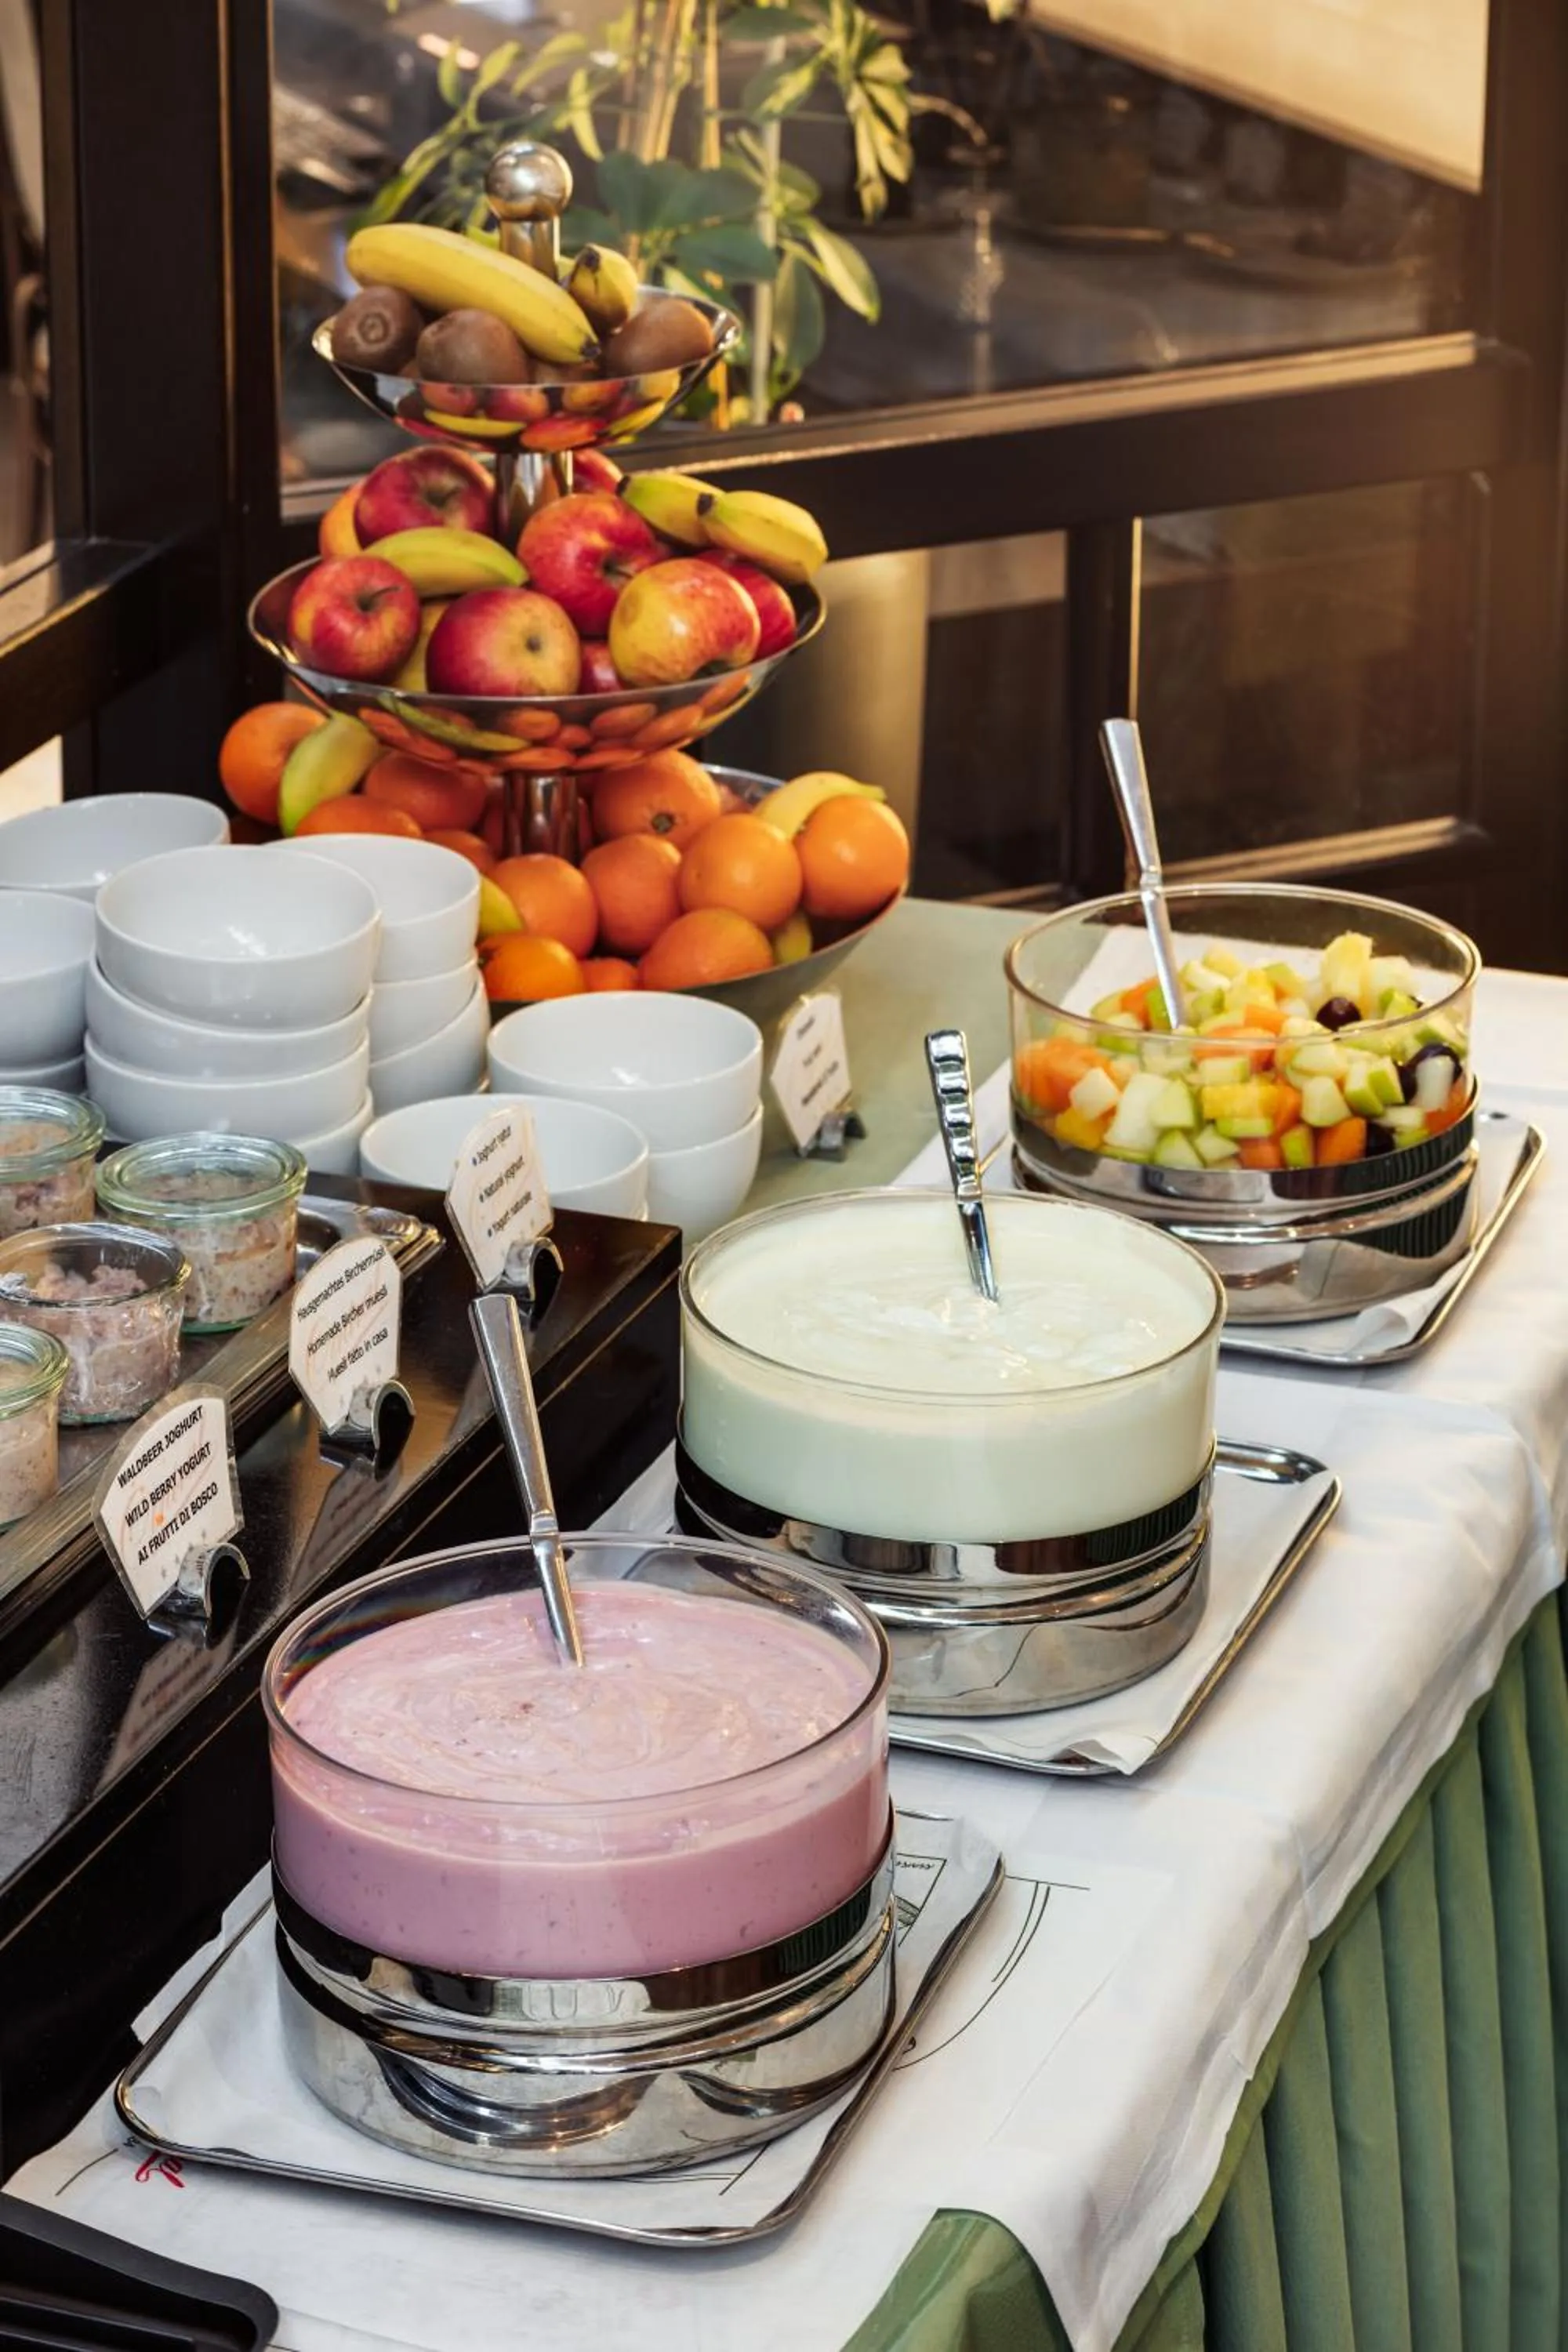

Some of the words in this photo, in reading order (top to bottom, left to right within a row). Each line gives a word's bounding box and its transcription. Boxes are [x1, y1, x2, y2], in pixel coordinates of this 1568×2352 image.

[297, 1275, 345, 1322] Hausgemachtes
[307, 1319, 343, 1356] Homemade
[341, 1302, 365, 1329] Bircher
[366, 1284, 388, 1310] muesli
[328, 1356, 347, 1384] Muesli
[347, 1345, 365, 1365] fatto
[372, 1327, 389, 1346] casa
[118, 1440, 164, 1489] WALDBEER
[164, 1405, 203, 1450] JOGHURT
[125, 1498, 149, 1528] WILD
[150, 1472, 176, 1507] BERRY
[177, 1442, 212, 1479] YOGURT
[137, 1547, 149, 1566] AI
[148, 1517, 180, 1554] FRUTTI
[180, 1506, 191, 1526] DI
[191, 1482, 219, 1515] BOSCO
